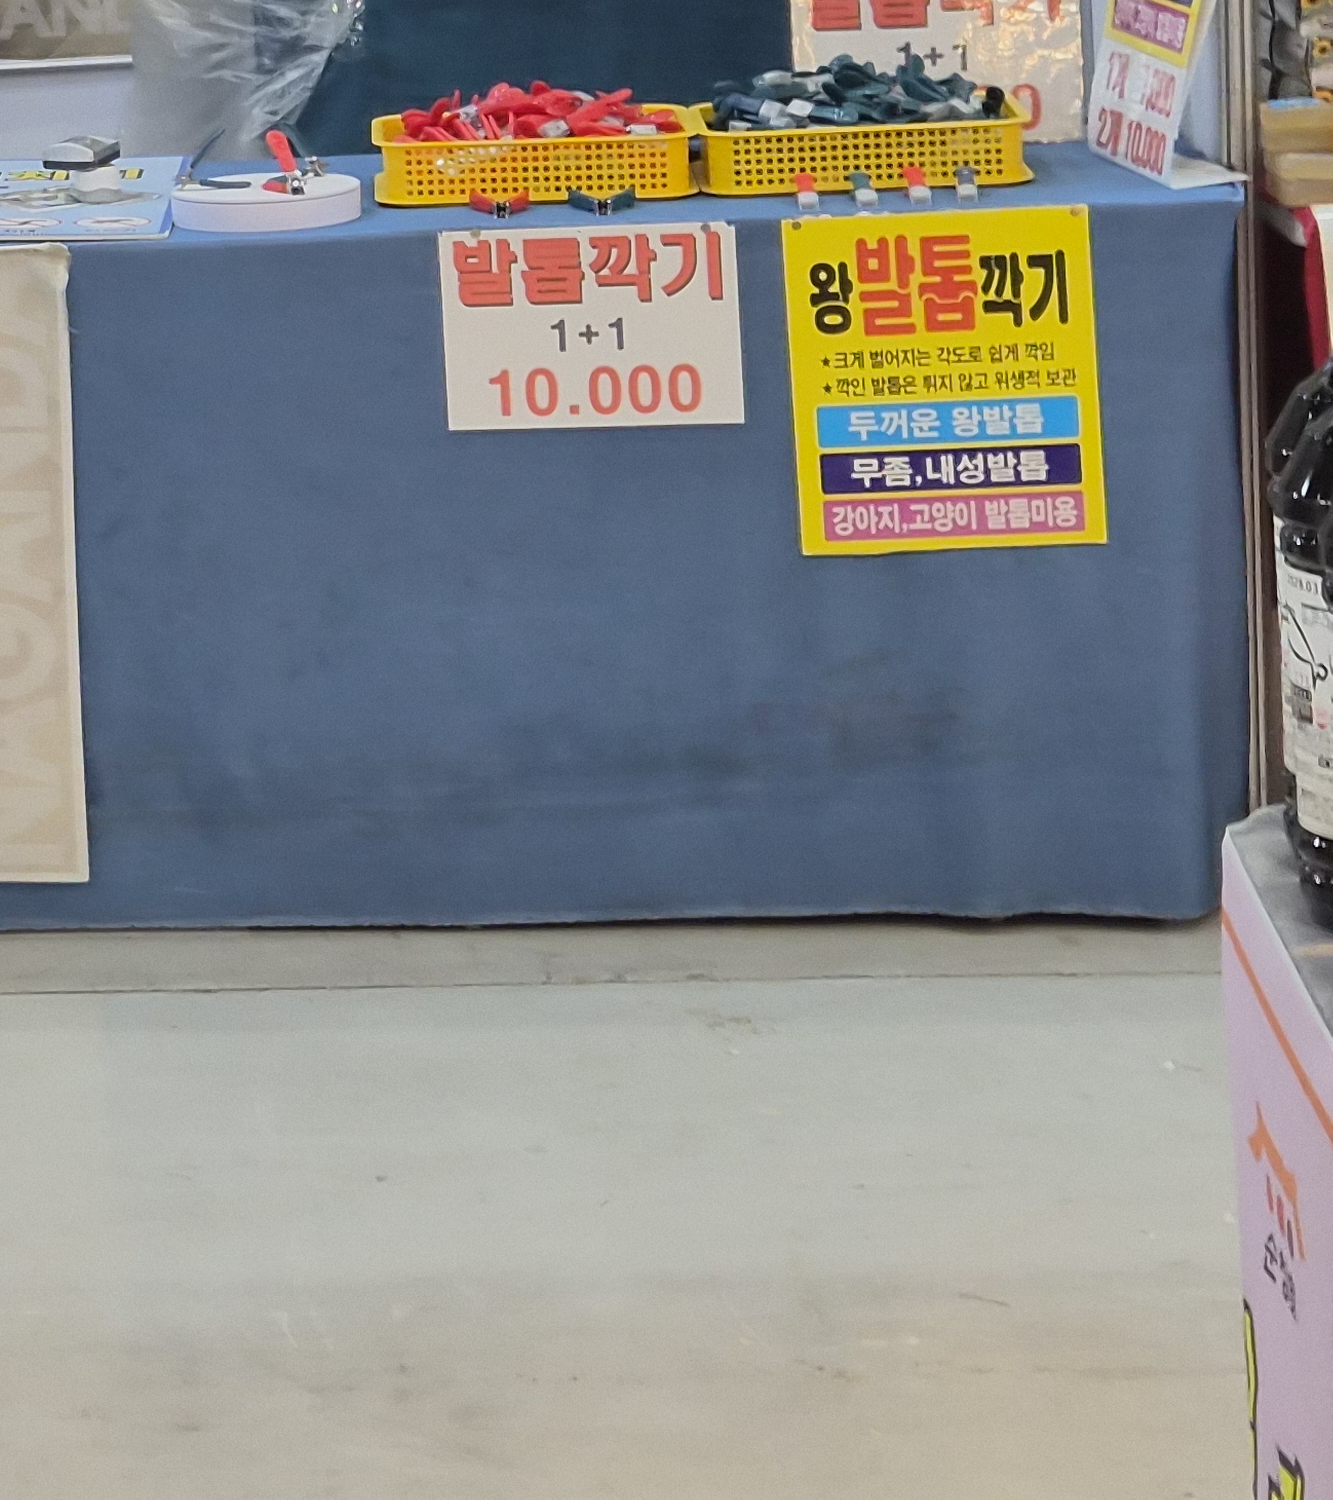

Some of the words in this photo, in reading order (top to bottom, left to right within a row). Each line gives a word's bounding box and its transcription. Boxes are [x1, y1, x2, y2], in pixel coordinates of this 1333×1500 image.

[550, 317, 626, 353] 1+1
[869, 349, 931, 369] 벌어지는
[936, 347, 983, 364] 각도로
[488, 363, 703, 417] 10.000
[1046, 368, 1077, 387] 보관
[848, 405, 940, 441] 두꺼운
[951, 402, 1044, 438] 왕발톱
[984, 496, 1077, 531] 발톱미용
